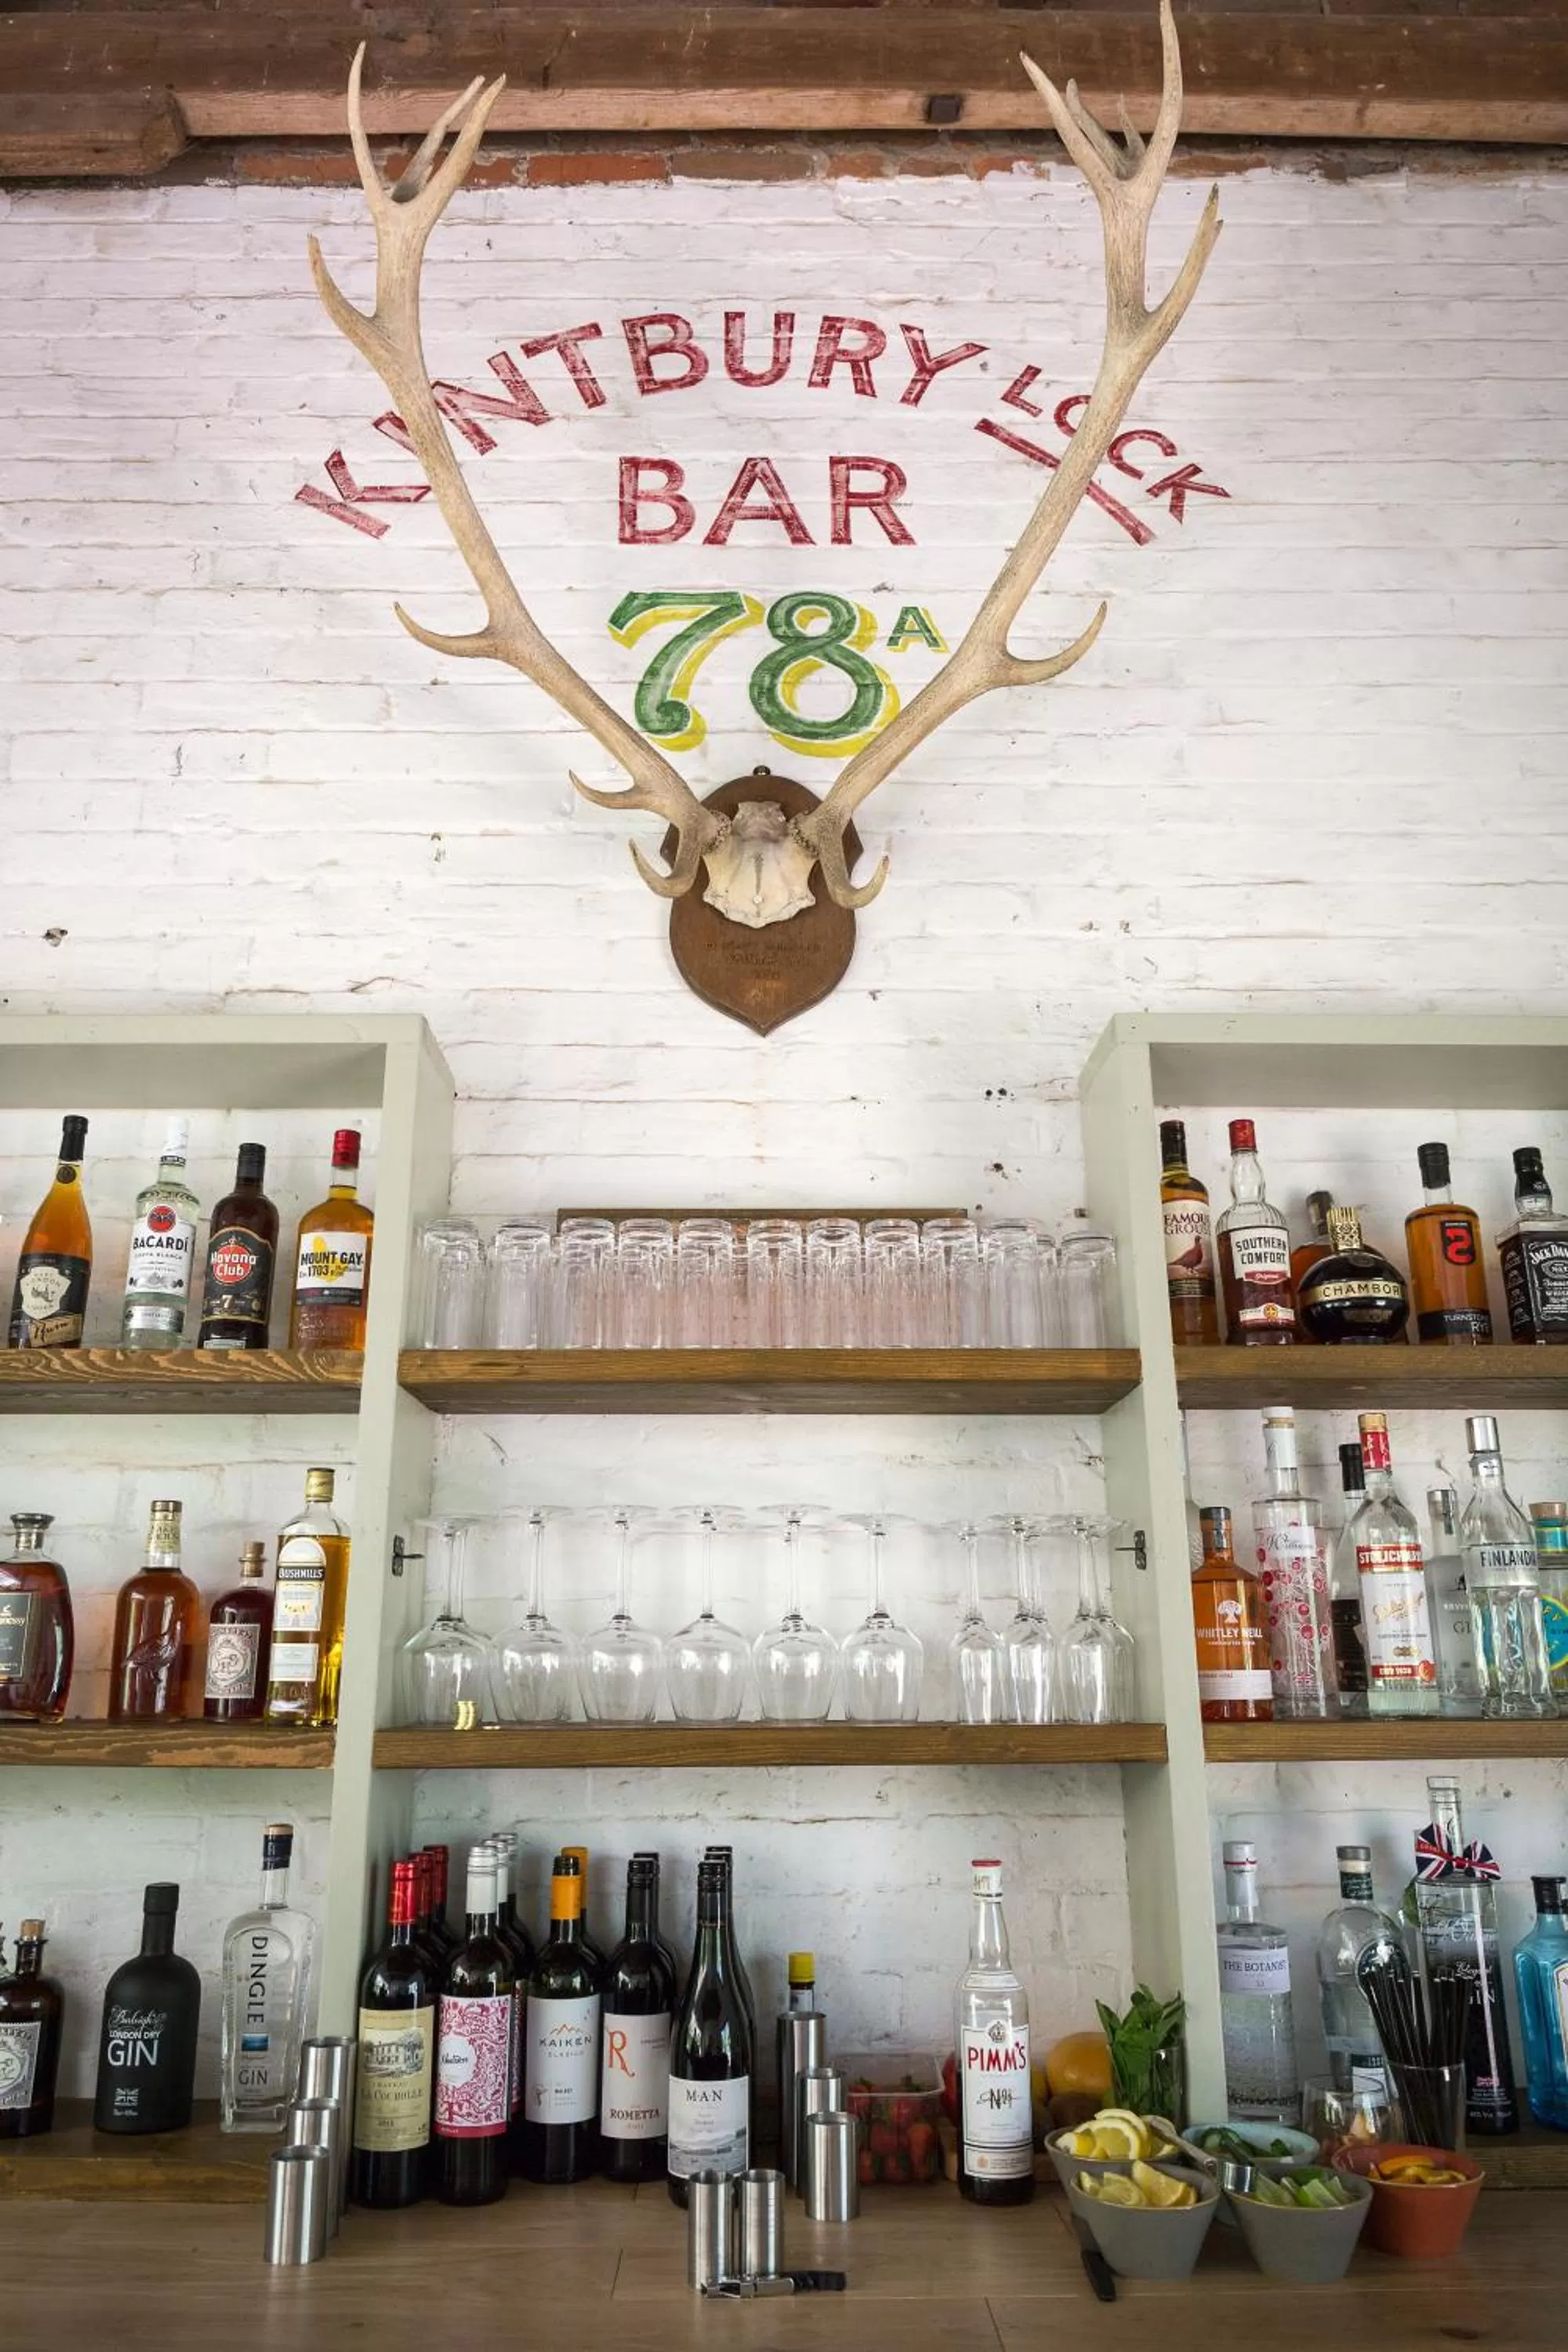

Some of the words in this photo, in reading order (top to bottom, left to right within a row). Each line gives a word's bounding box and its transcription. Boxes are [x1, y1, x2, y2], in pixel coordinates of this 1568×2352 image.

[618, 456, 916, 546] BAR
[1236, 1236, 1287, 1252] SOUTHERN
[210, 1250, 256, 1265] Havana
[300, 1251, 337, 1266] MOUNT
[339, 1252, 363, 1265] GAY
[1241, 1252, 1286, 1265] COMFORT
[1530, 1246, 1551, 1265] JACK
[216, 1263, 245, 1276] Club
[222, 1294, 233, 1308] 7
[278, 1567, 323, 1579] BUSHMILLS
[1196, 1627, 1240, 1639] WHITLEY
[1223, 1961, 1243, 1972] THE
[247, 1936, 269, 2024] DINGLE
[109, 2031, 142, 2039] LONDON
[539, 2036, 592, 2048] KAIKEN
[107, 2039, 158, 2067] GIN
[608, 2030, 636, 2078] R
[967, 2041, 1027, 2072] PIMM'S
[238, 2068, 268, 2086] GIN
[609, 2108, 660, 2121] ROMETTA
